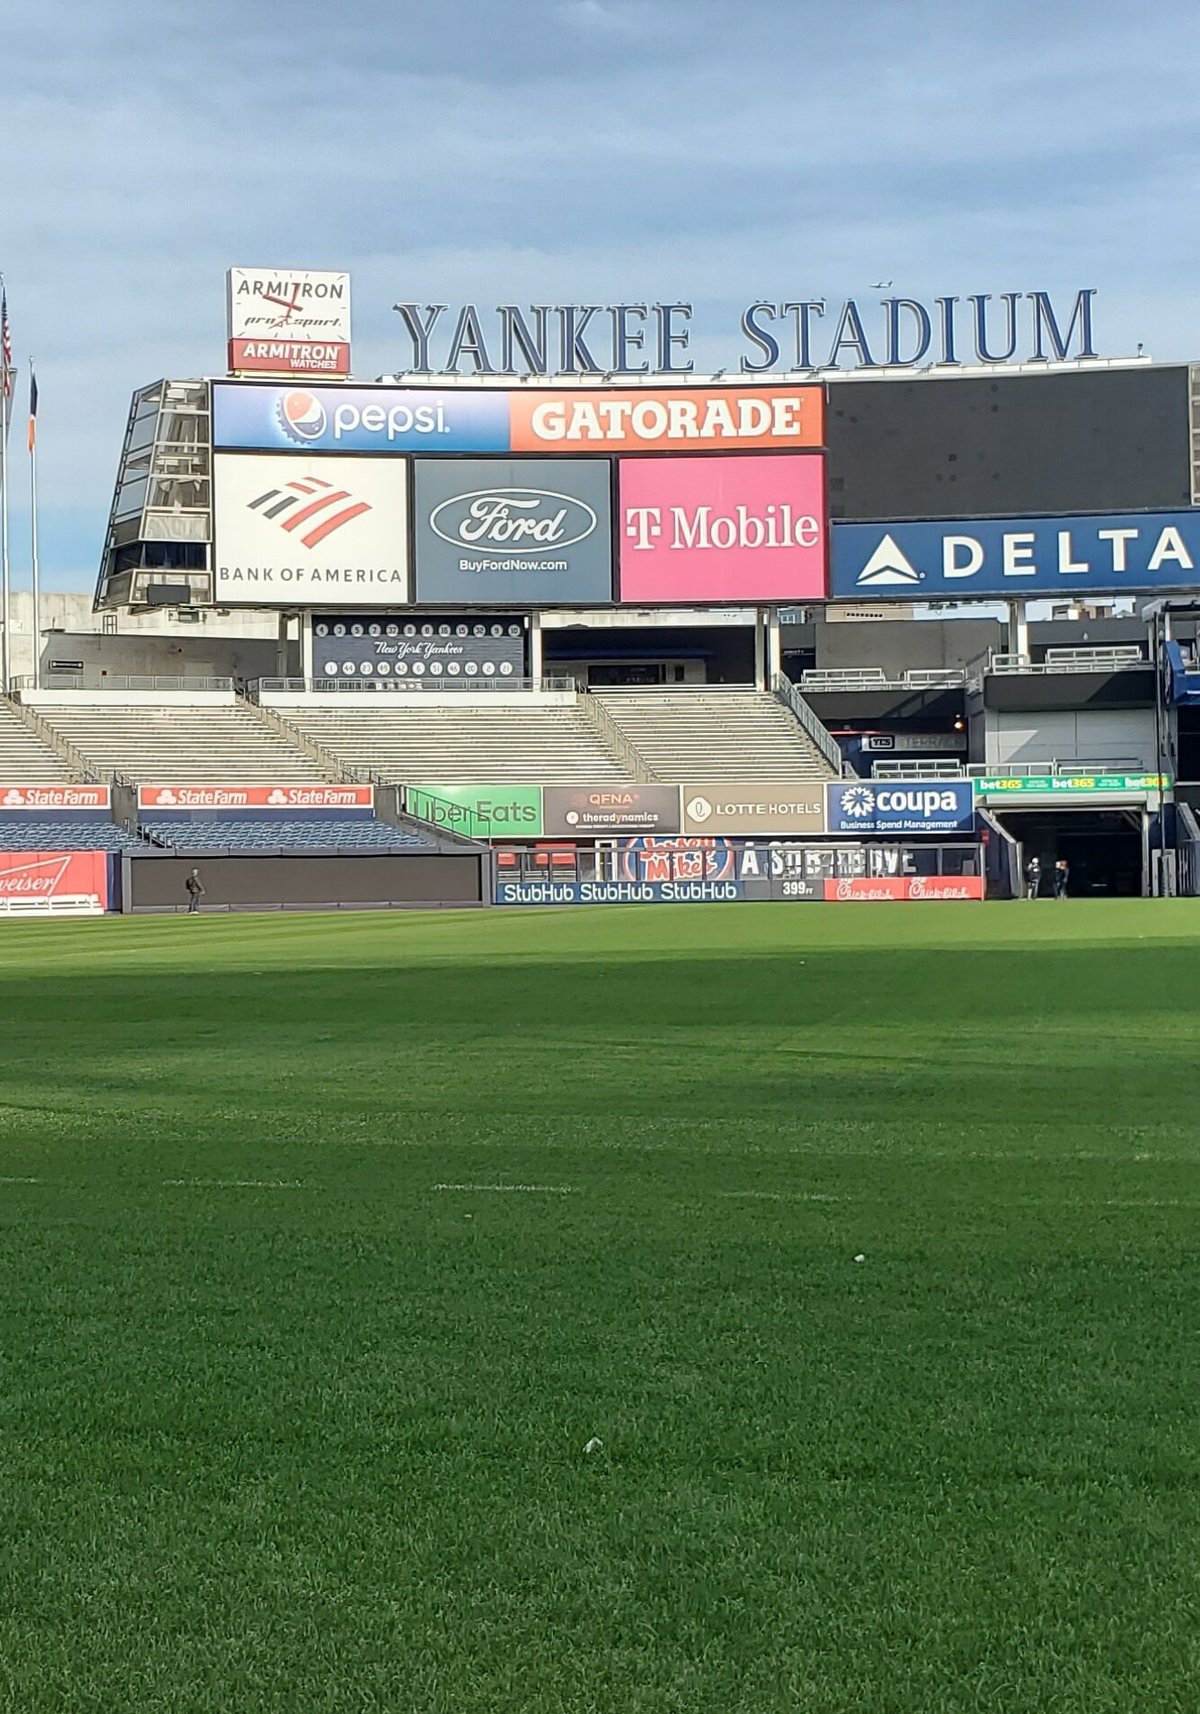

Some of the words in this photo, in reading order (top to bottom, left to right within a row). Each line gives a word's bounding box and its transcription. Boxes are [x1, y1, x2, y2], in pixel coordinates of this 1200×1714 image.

[237, 279, 343, 299] ARMITRON
[393, 302, 695, 376] YANKEE
[741, 288, 1099, 374] STADIUM
[243, 342, 338, 360] ARMITRON
[290, 358, 337, 369] WATCHES
[531, 397, 801, 441] GATORADE
[459, 496, 567, 542] Ford
[669, 504, 820, 550] Mobile
[942, 526, 1194, 579] DELTA
[220, 567, 273, 581] BANK
[280, 567, 305, 582] OF
[310, 568, 402, 583] AMERICA
[459, 559, 568, 573] BuyFordNow.com
[374, 641, 398, 653] New
[397, 642, 423, 659] York
[422, 642, 463, 659] Yankees
[476, 800, 537, 822] Eats
[716, 803, 766, 815] LOTTE
[768, 803, 821, 815] HOTELS
[876, 791, 958, 818] coupa
[840, 820, 875, 829] Business
[876, 820, 903, 830] Spend
[903, 820, 958, 830] Management
[741, 841, 760, 874] A
[504, 883, 574, 901] StubHub
[580, 883, 654, 901] StubHub
[660, 882, 737, 900] StubHub
